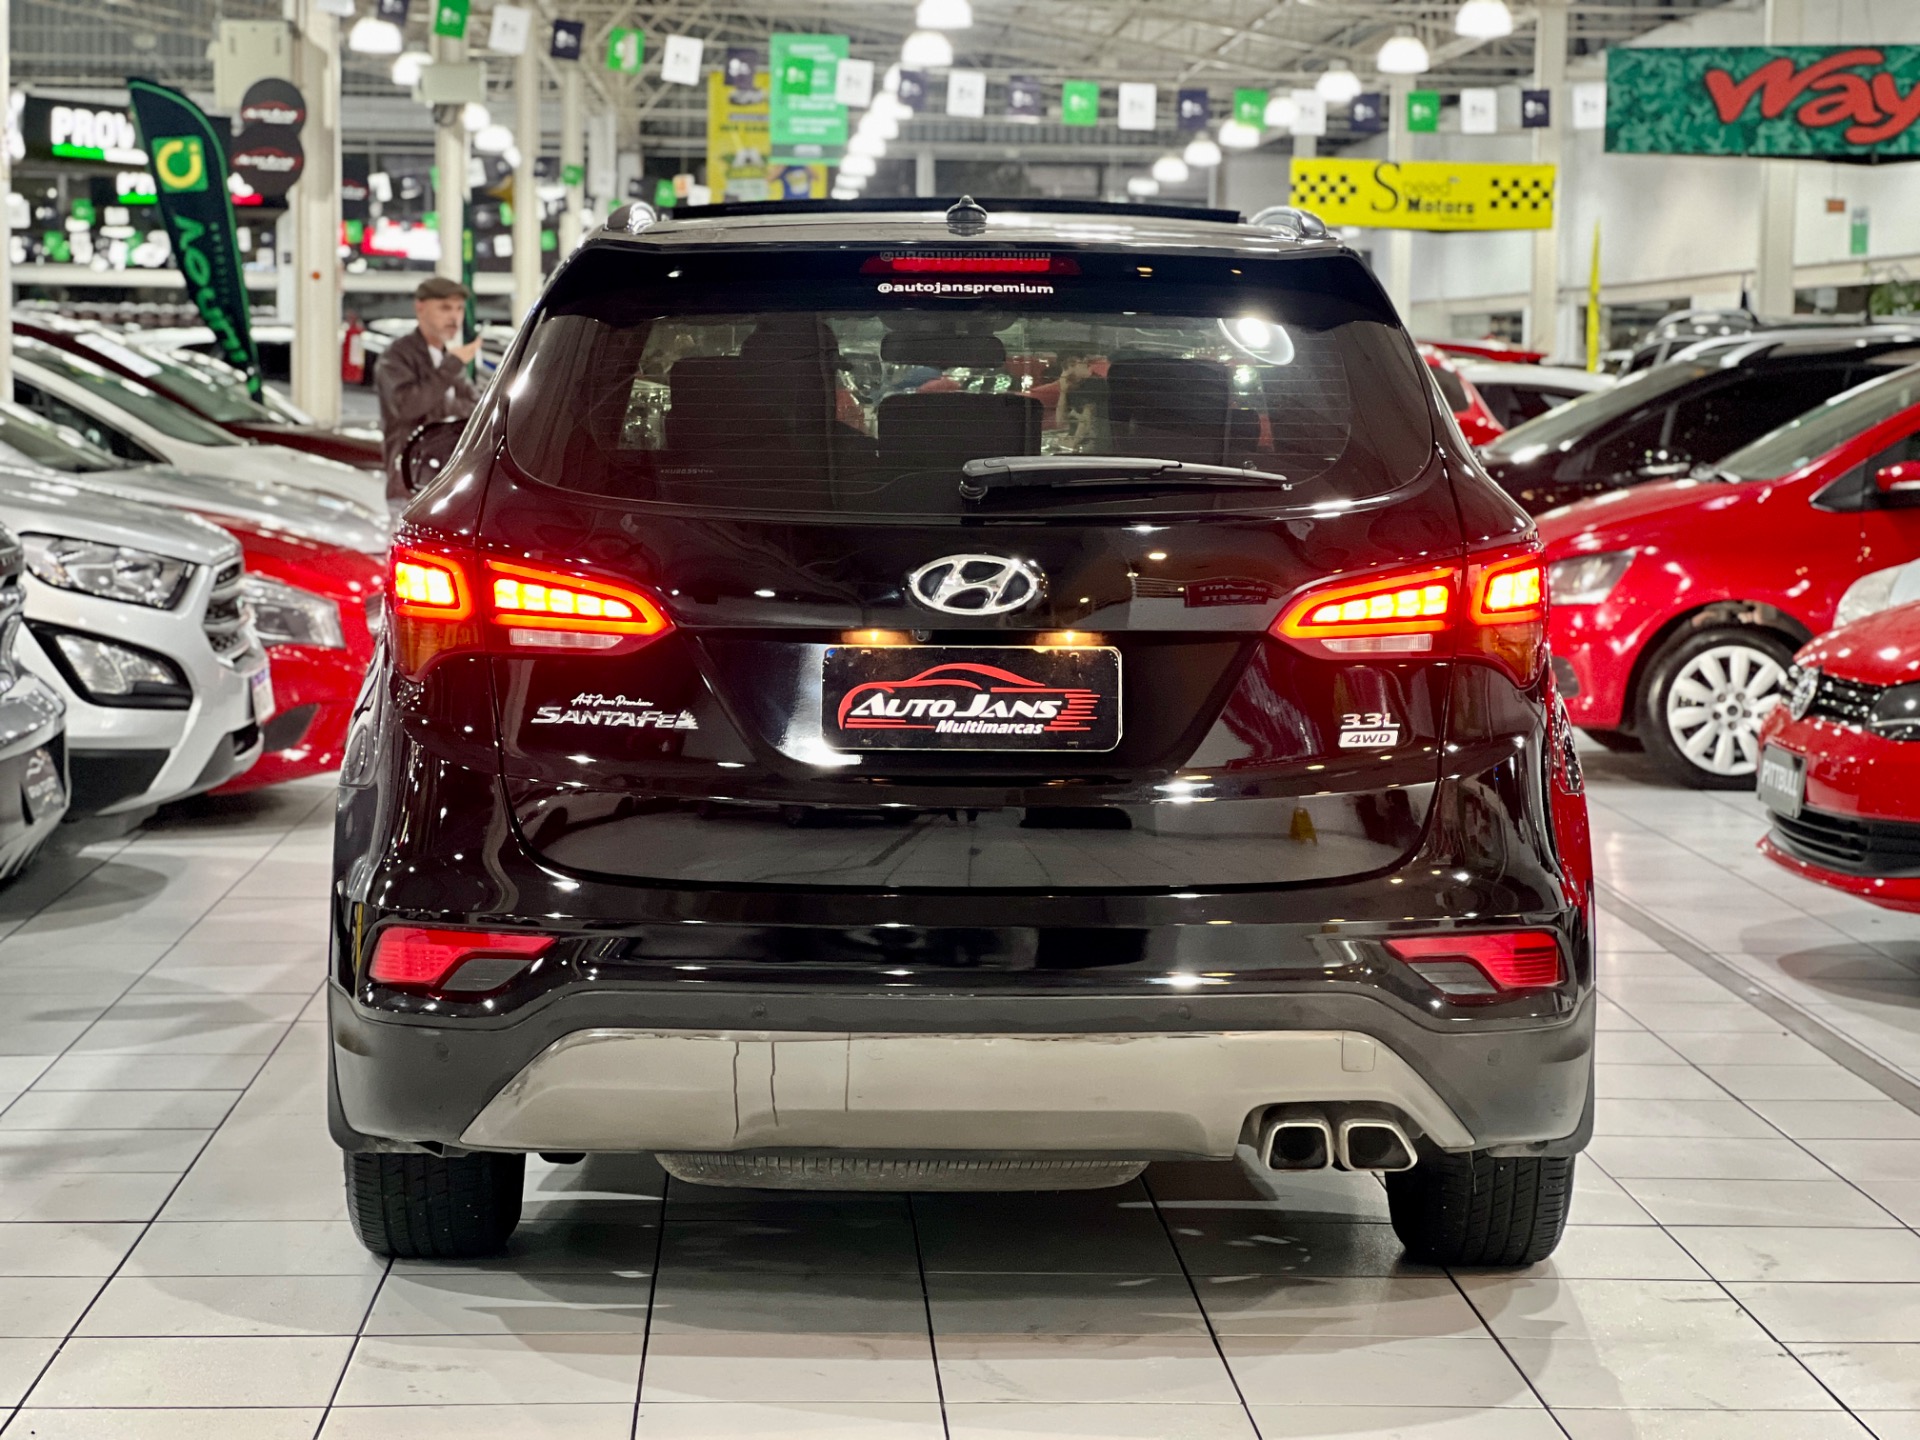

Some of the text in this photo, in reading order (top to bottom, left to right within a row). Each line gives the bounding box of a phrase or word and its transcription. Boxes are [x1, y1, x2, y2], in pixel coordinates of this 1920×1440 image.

[877, 282, 1054, 294] @autojanspremium
[935, 719, 1044, 734] Multimarcas
[1347, 734, 1391, 744] 4WD
